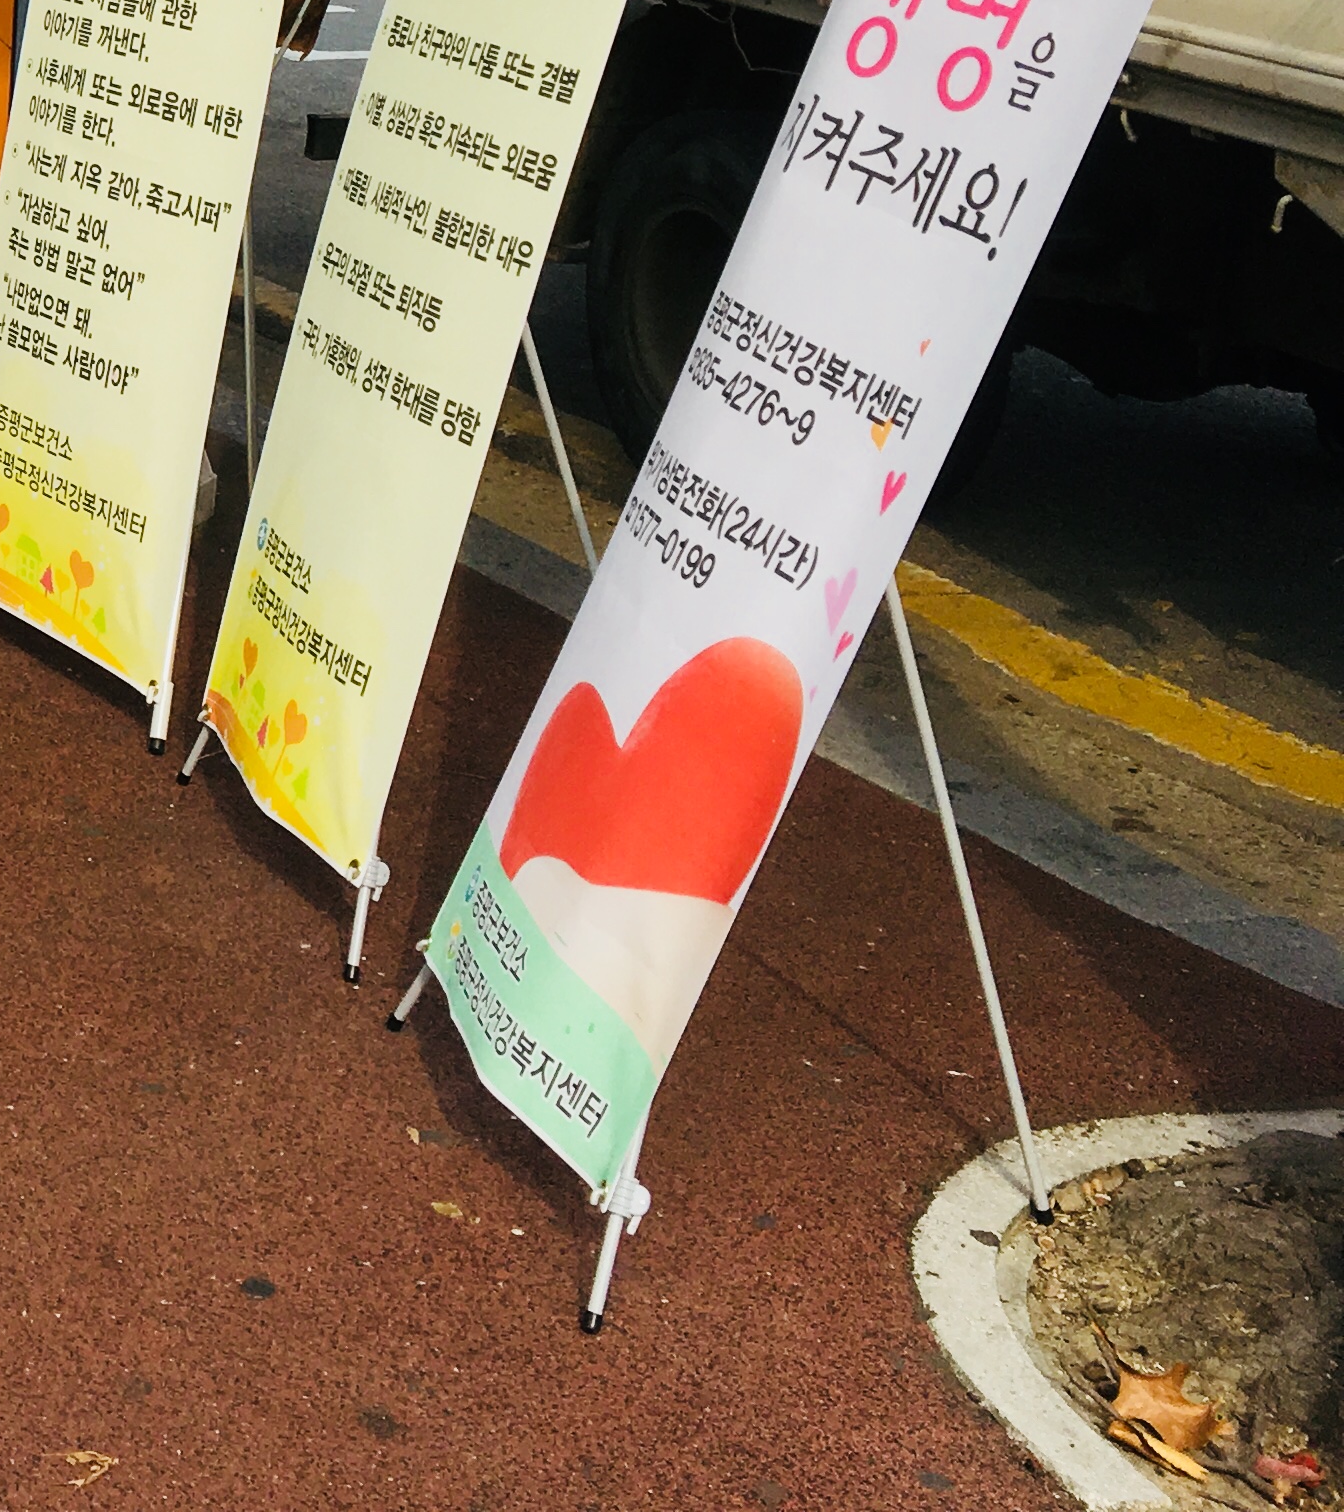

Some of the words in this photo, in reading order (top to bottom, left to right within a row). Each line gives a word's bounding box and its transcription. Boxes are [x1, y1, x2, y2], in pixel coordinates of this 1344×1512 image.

[44, 10, 93, 48] 이야기를
[97, 25, 149, 63] 꺼낸다.
[418, 24, 471, 70] 친구와의
[468, 42, 501, 80] 다툼
[498, 51, 535, 92] 또는
[538, 62, 580, 105] 결별
[29, 96, 77, 136] 이야기를
[82, 110, 115, 148] 한다.
[35, 58, 87, 97] 사후세계
[89, 74, 123, 107] 또는
[128, 84, 199, 128] 외로움에
[204, 105, 243, 140] 대한
[70, 161, 102, 195] 지옥
[386, 101, 421, 141] 상실감
[418, 111, 446, 151] 혹은
[443, 124, 500, 172] 지속되는
[501, 144, 558, 192] 외로움
[782, 95, 1028, 261] 지켜주세요!
[8, 227, 30, 261] 죽는
[33, 238, 61, 274] 방법
[65, 250, 97, 287] 말곤
[101, 264, 146, 301] 없어”
[371, 182, 406, 222] 사회적
[403, 195, 432, 236] 낙인,
[432, 208, 495, 262] 불합리한
[496, 236, 534, 277] 대우
[321, 242, 352, 285] 욕구의
[347, 259, 374, 298] 좌절
[368, 271, 396, 311] 또는
[395, 285, 443, 333] 퇴직등
[7, 319, 58, 366] 쓸모없는
[361, 359, 393, 402] 성적
[390, 372, 440, 427] 학대를
[441, 400, 481, 447] 당함
[265, 528, 312, 594] 증평군보건소
[252, 575, 372, 696] 증평군정신건강복지센터
[471, 879, 531, 982] 증평군보건소
[455, 935, 609, 1139] 증평군정신건강복지센터
